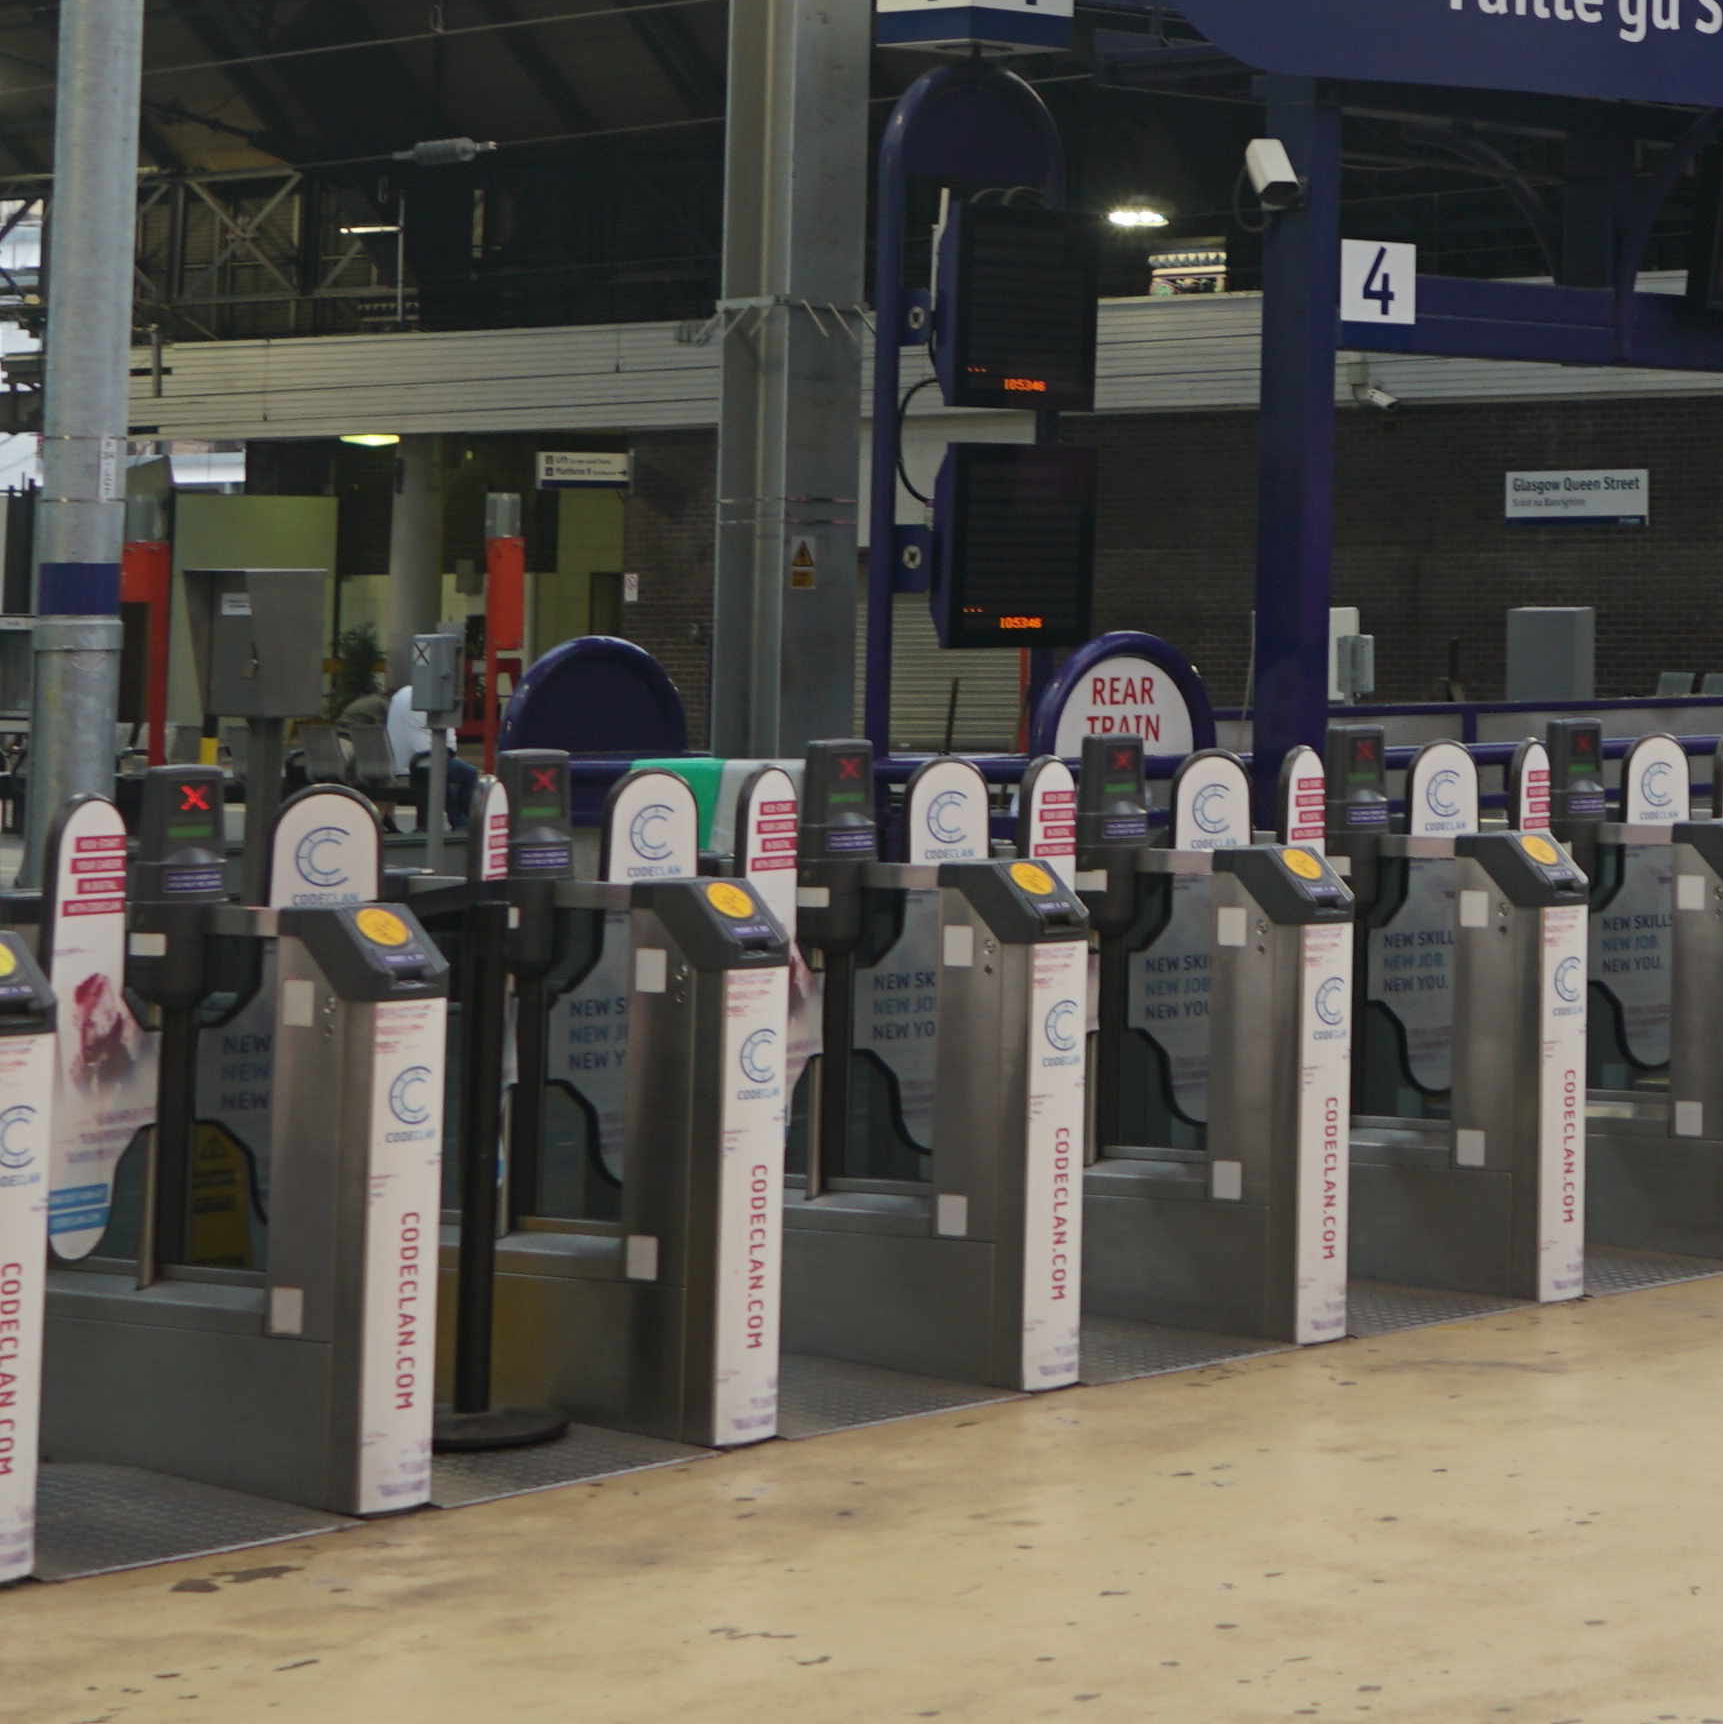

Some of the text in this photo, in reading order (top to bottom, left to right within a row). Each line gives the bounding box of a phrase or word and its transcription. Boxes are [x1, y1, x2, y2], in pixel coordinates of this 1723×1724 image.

[1362, 245, 1395, 317] 4
[1513, 476, 1640, 494] Glasgow Queen Street
[1092, 677, 1154, 707] REAR
[1086, 714, 1161, 744] TRAIN
[1425, 821, 1467, 832] CODECLAN
[925, 848, 974, 860] CODECLAN
[627, 865, 682, 877] CODECLAN
[1383, 933, 1415, 950] NEW
[1383, 953, 1415, 970] NEW
[1383, 975, 1415, 993] NEW
[1562, 1069, 1576, 1224] CODECLAN.COM
[1322, 1096, 1338, 1261] CODECLAN.COM
[1051, 1126, 1070, 1301] CODECLAN.COM
[746, 1163, 768, 1350] CODECLAN.COM
[394, 1211, 420, 1411] CODECLAN.COM
